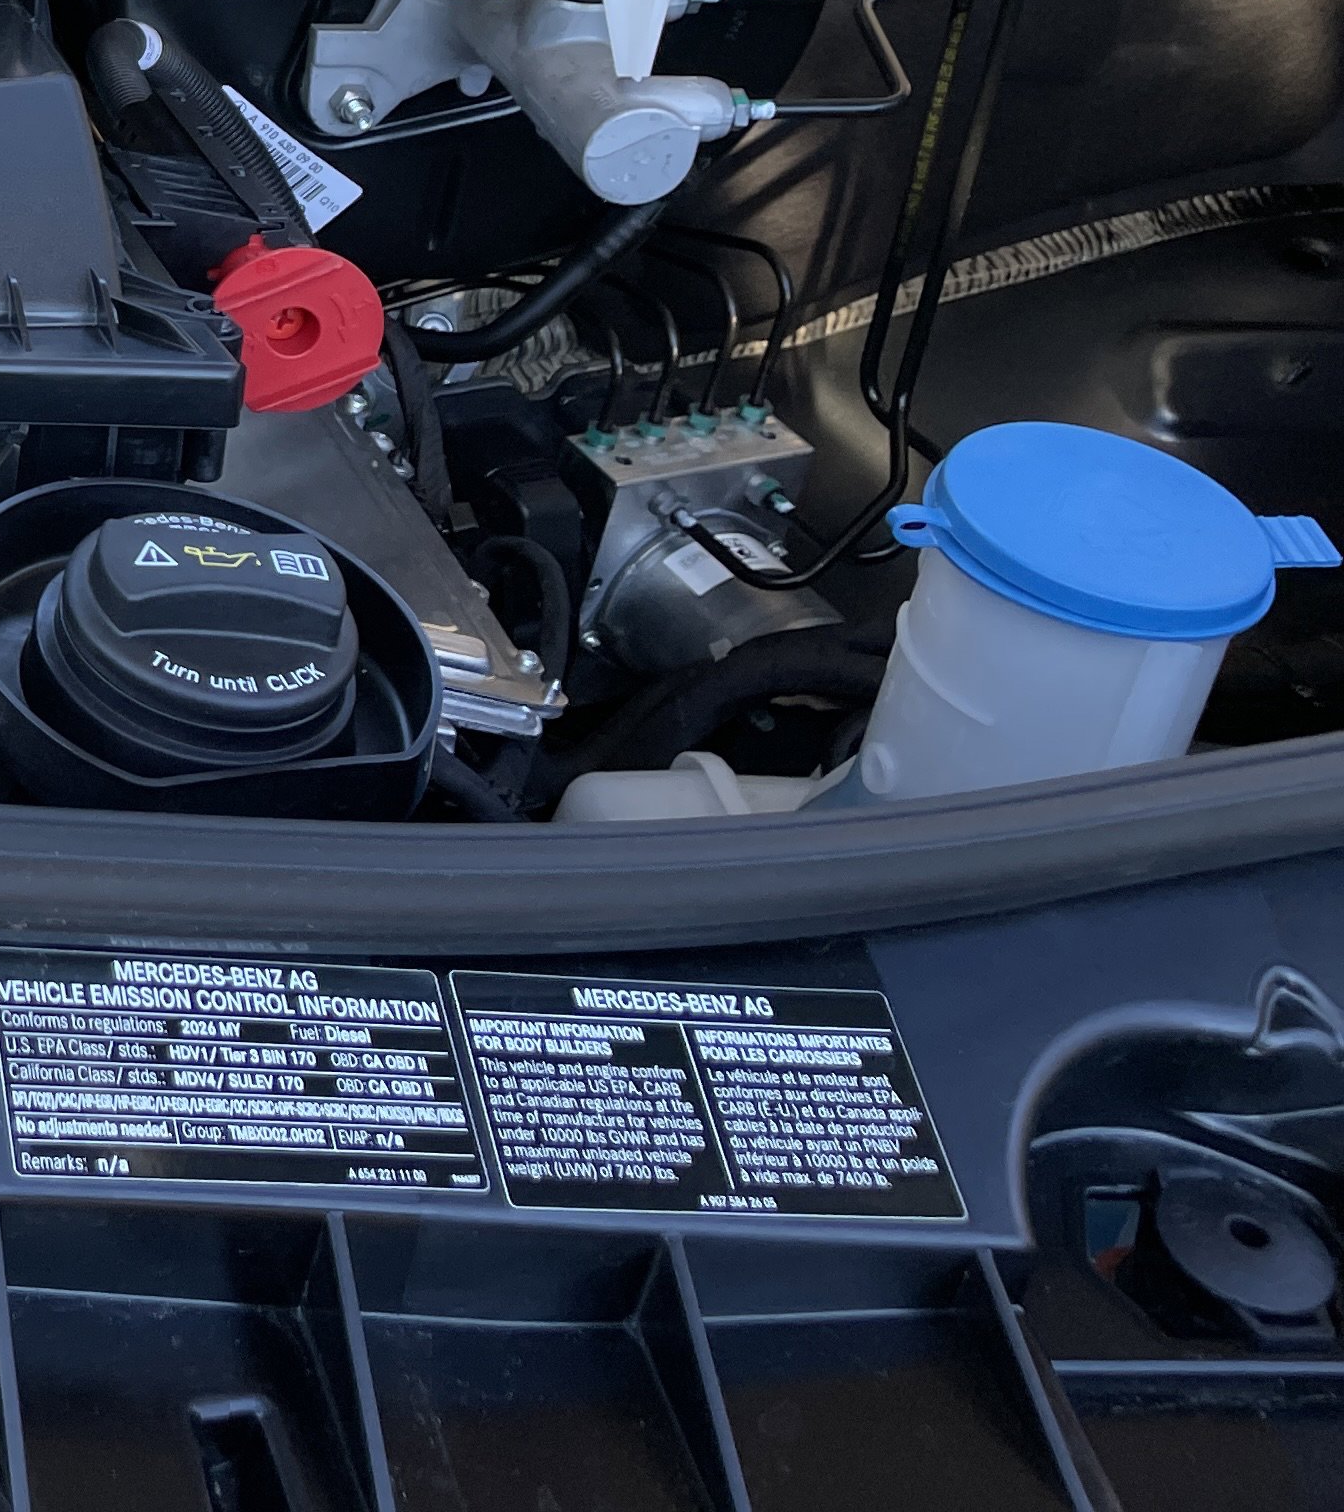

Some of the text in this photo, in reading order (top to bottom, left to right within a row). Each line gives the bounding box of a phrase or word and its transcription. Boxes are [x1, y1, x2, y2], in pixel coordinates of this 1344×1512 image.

[151, 649, 326, 694] Turn until CLICK
[114, 961, 318, 991] MERCEDES-BENZ AG
[90, 984, 191, 1009] EMISSION
[196, 990, 295, 1014] CONTROL
[299, 996, 439, 1021] INFORMATION
[574, 988, 773, 1016] MERCEDES-BENZ AG
[1, 1010, 240, 1037] Conforms to regulations: 2026 MY
[290, 1024, 371, 1044] Fuel: Diesel
[470, 1019, 644, 1041] IMPORTANT INFORMATION
[5, 1036, 316, 1066] U.S. EPA Class/ stds.: HDV1/ Tier 3 BIN 170
[474, 1035, 612, 1055] FOR BODY BUILDERS
[695, 1030, 892, 1051] INFORMATIONS IMPORTANTES
[331, 1052, 428, 1072] OBD: CA OBD II
[700, 1046, 861, 1065] POUR LES CARROSSIERS
[9, 1062, 304, 1091] California Class/ stds.: MDV4/ SULEV 170
[478, 1057, 686, 1080] This vehicle and engine conform
[336, 1078, 434, 1097] OBD: CA OBD II
[484, 1075, 681, 1096] to all applicable US EPA, CARB
[489, 1092, 694, 1113] and Canadian regulations at the
[15, 1116, 172, 1139] No adjustments needed.
[493, 1108, 703, 1130] time of manufacture for vehicles
[338, 1129, 404, 1149] EVAP: n/a
[498, 1127, 705, 1147] under 10000 lbs GVWR and has
[22, 1152, 129, 1175] Remarks: n/a
[503, 1145, 692, 1163] a maximum unloaded vehicle
[349, 1167, 427, 1182] A 654 221 11 00
[506, 1161, 679, 1180] weight (UVW) of 7400 lbs.
